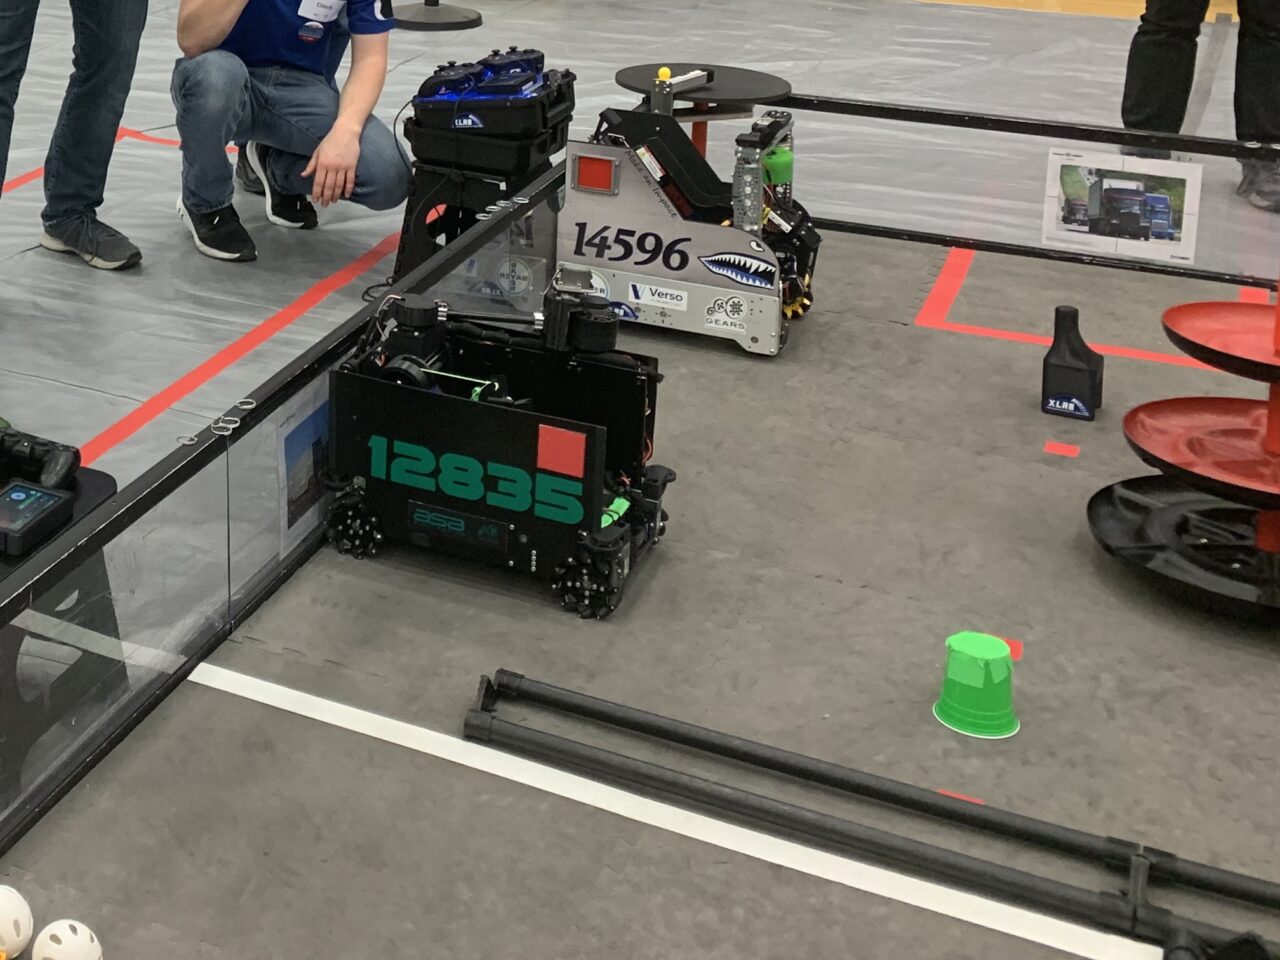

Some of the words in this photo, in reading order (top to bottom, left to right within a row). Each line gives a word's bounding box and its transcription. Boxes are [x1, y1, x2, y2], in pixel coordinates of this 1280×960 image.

[574, 221, 692, 272] 14596
[649, 288, 683, 302] Verso
[706, 317, 745, 330] GEARS
[1048, 399, 1075, 411] XLAB
[368, 434, 585, 525] 12835
